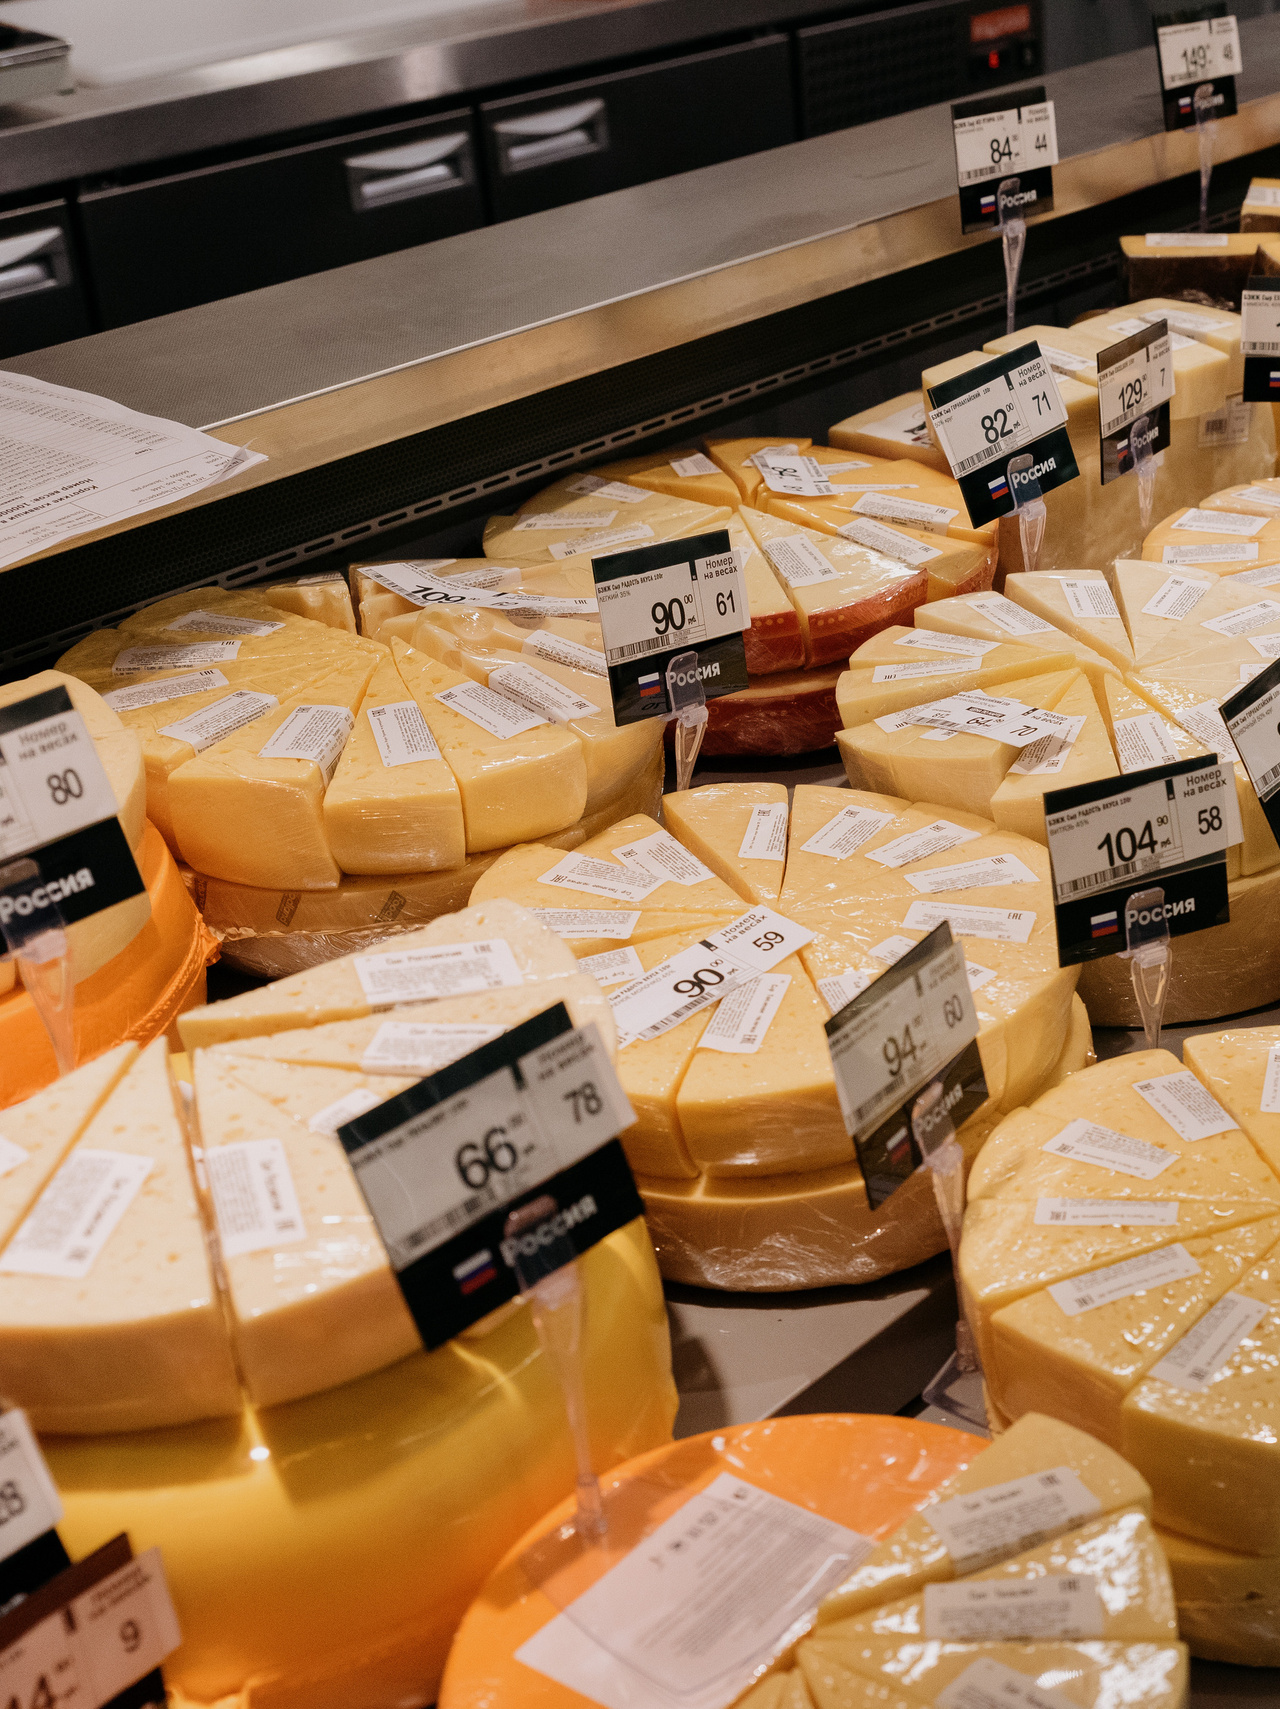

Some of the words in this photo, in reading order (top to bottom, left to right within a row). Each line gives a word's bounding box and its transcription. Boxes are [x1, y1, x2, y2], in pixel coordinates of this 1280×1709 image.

[990, 137, 1012, 163] 84
[1035, 134, 1047, 152] 44
[1018, 361, 1042, 378] Номер
[1019, 379, 1027, 387] на
[1028, 368, 1047, 384] весах
[1160, 367, 1165, 387] 7
[1006, 402, 1015, 413] 00
[1031, 390, 1051, 416] 71
[1118, 378, 1143, 412] 129
[981, 408, 1014, 444] 82
[1132, 426, 1159, 448] Россия
[60, 477, 92, 492] Номер
[1010, 457, 1056, 489] Россия
[704, 572, 713, 580] на
[715, 565, 738, 578] весах
[705, 556, 733, 570] Номер
[412, 584, 466, 604] 109
[612, 583, 621, 591] Сыр
[621, 578, 640, 589] РАДОСТЬ
[640, 575, 653, 585] ВКУСА
[684, 594, 693, 604] 00
[716, 590, 736, 616] 61
[651, 598, 685, 635] 90
[666, 662, 721, 689] Россия
[1010, 725, 1038, 737] 70
[48, 768, 83, 805] 80
[1183, 788, 1195, 798] на
[1197, 779, 1227, 795] весах
[1186, 769, 1222, 787] Номер
[1078, 806, 1101, 819] РАДОСТЬ
[1102, 801, 1119, 811] ВКУСА
[1156, 815, 1168, 826] 90
[1198, 806, 1222, 835] 58
[1097, 820, 1158, 866] 104
[0, 867, 96, 924] Россия
[721, 913, 757, 938] Номер
[1127, 898, 1195, 929] Россия
[725, 935, 738, 944] на
[738, 915, 767, 934] весах
[752, 931, 785, 951] 59
[709, 958, 724, 968] 00
[673, 968, 725, 999] 90
[943, 994, 964, 1029] 60
[882, 1023, 917, 1077] 94
[562, 1081, 603, 1123] 78
[916, 1082, 964, 1134] Россия
[456, 1127, 517, 1189] 66
[500, 1195, 597, 1267] Россия
[0, 1480, 25, 1526] 8
[120, 1618, 140, 1654] 9
